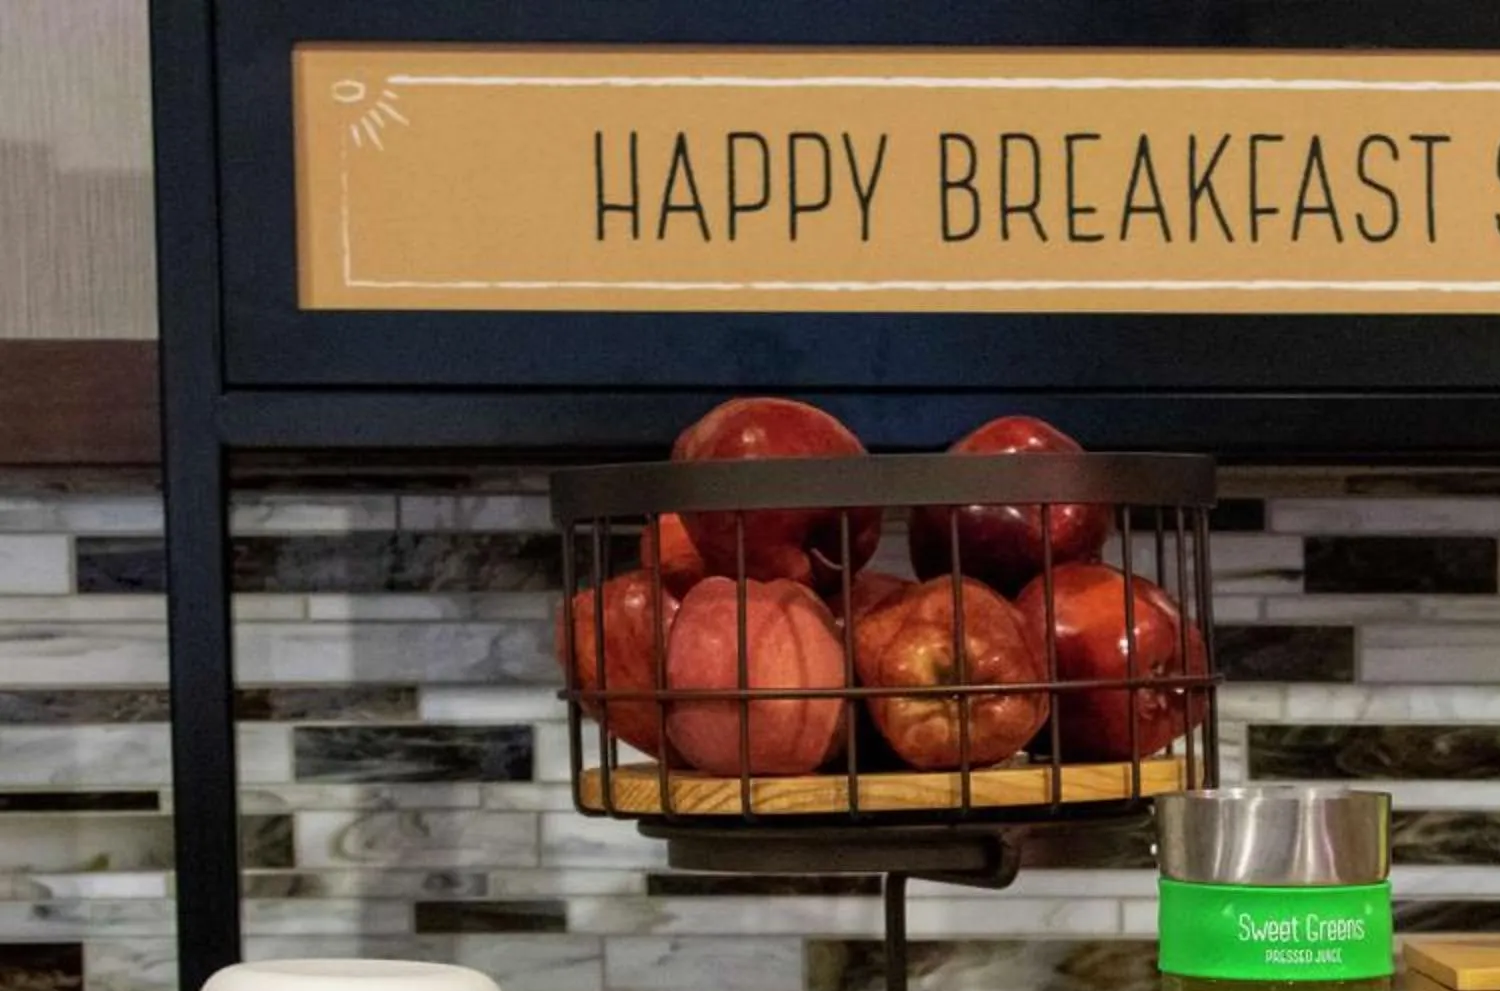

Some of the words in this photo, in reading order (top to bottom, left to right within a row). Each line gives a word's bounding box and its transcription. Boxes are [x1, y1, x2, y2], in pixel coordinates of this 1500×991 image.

[595, 130, 888, 243] HAPPY
[939, 132, 1452, 245] BREAKFAST
[1238, 912, 1299, 943] Sweet
[1306, 913, 1366, 942] Greens
[1265, 949, 1313, 963] PRESSED
[1315, 948, 1343, 963] JUICE
